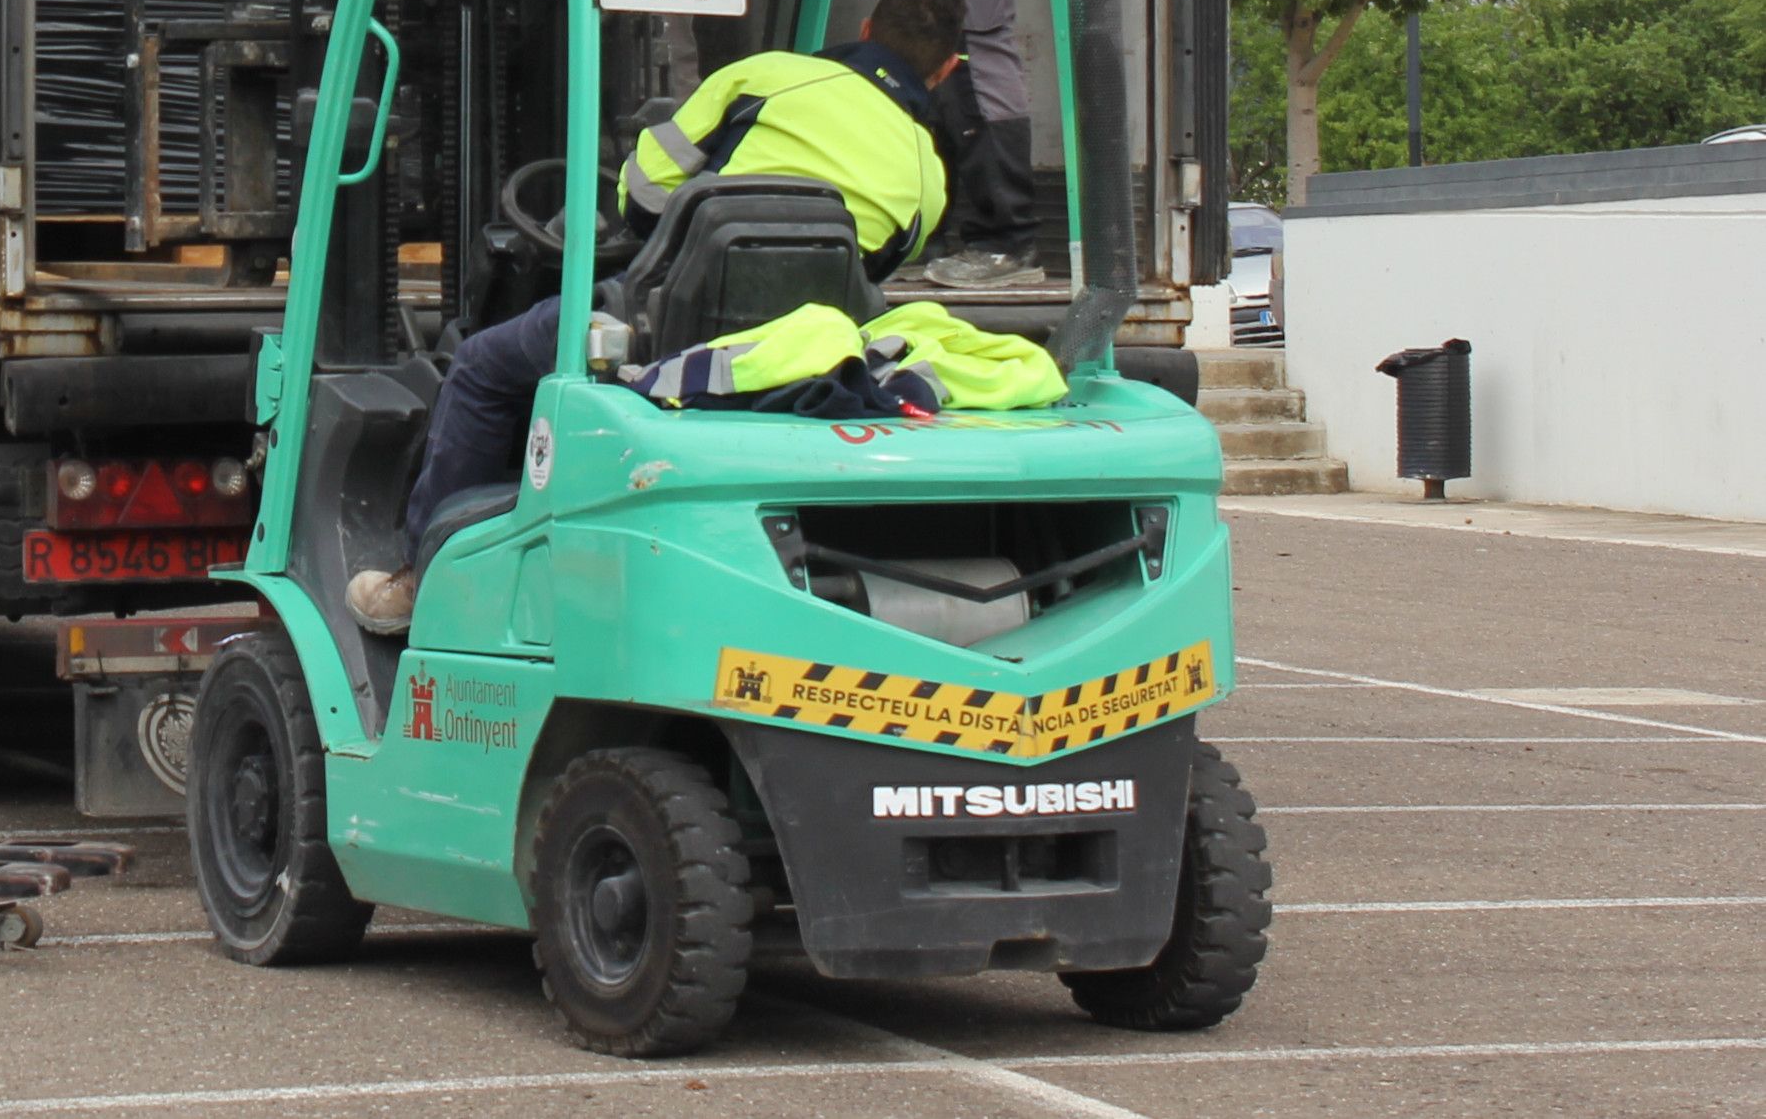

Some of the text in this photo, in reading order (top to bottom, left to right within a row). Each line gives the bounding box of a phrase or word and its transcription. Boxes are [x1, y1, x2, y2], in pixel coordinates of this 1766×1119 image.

[30, 537, 52, 576] R
[70, 533, 170, 575] 8546
[446, 673, 517, 707] Ajuntament
[791, 683, 919, 719] RESPECTEU
[924, 704, 952, 725] LA
[1078, 702, 1099, 723] DE
[1102, 676, 1179, 717] SEGURETAT
[444, 711, 517, 754] Ontinyent
[873, 779, 1136, 818] MITSUBISHI
